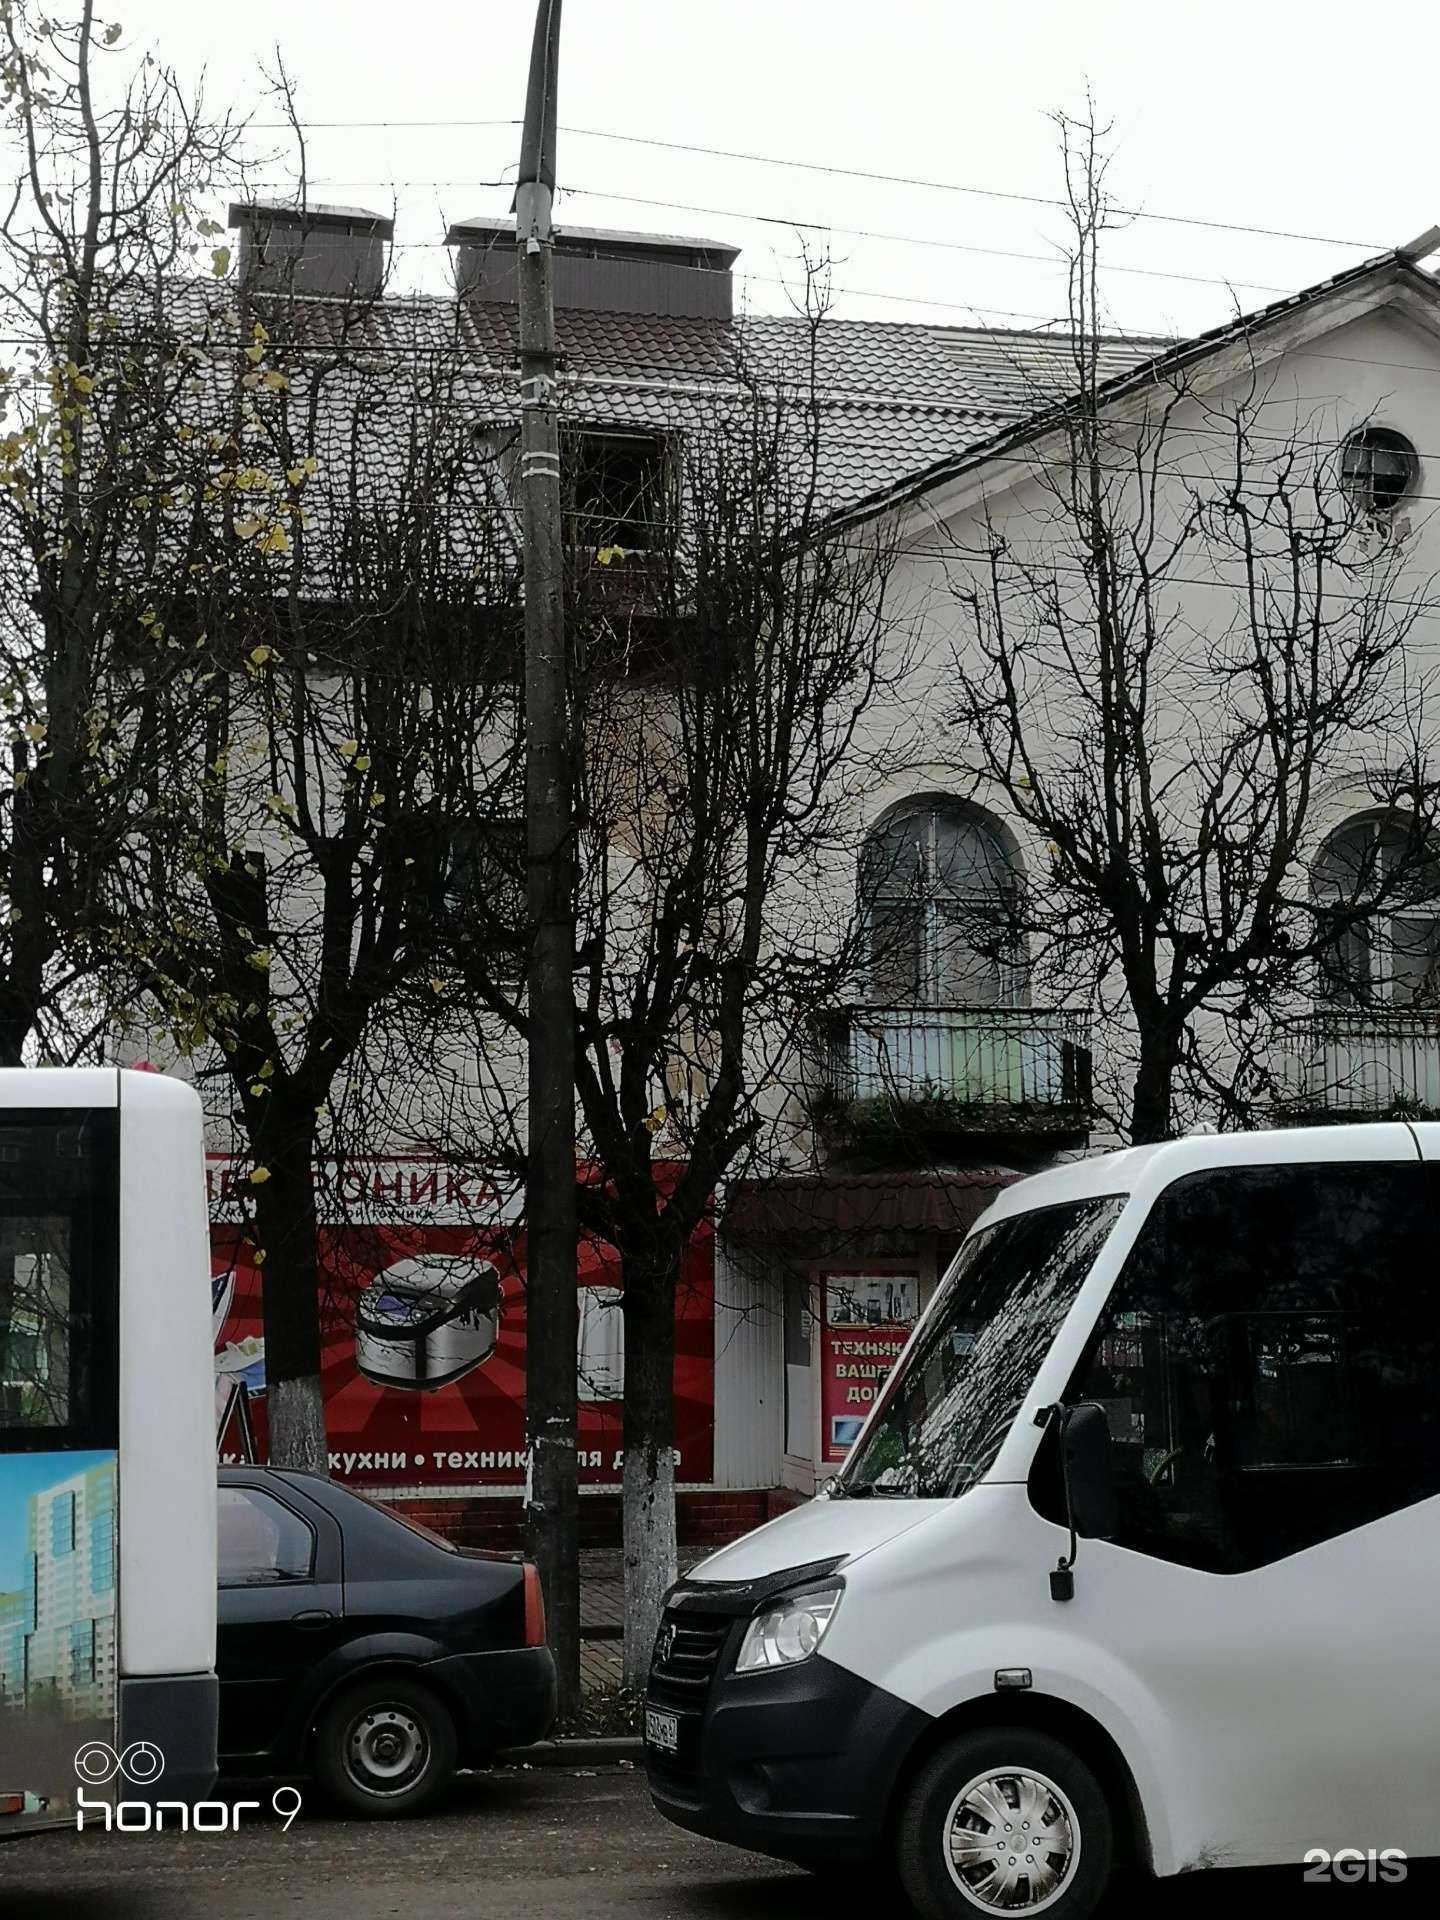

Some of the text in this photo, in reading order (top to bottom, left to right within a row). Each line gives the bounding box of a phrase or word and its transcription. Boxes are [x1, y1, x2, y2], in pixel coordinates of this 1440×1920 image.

[831, 1341, 904, 1356] ТЕХНИК
[327, 1451, 407, 1475] кухни
[432, 1451, 530, 1469] техник
